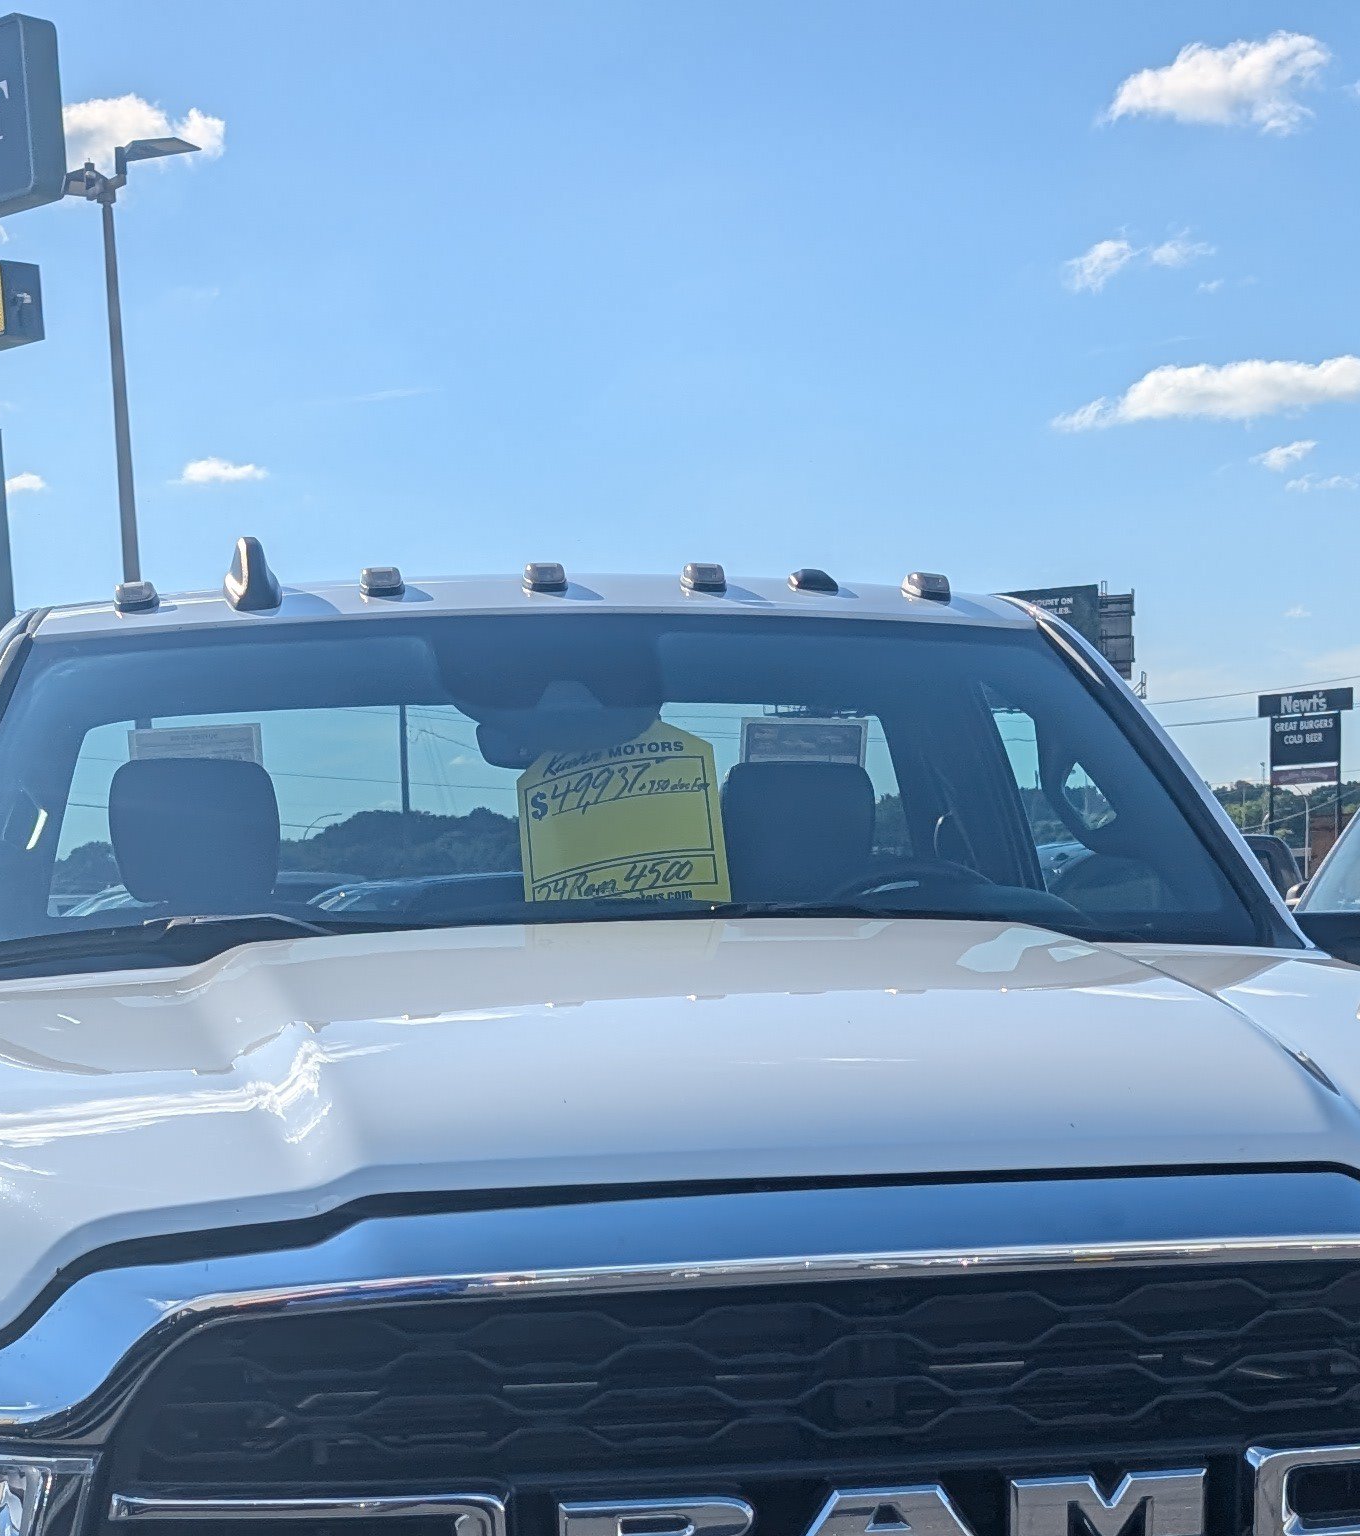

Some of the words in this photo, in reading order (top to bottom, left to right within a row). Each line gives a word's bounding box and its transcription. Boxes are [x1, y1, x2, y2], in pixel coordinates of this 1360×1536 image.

[1280, 691, 1327, 714] Newt's
[1274, 721, 1298, 732] GREAT
[1300, 718, 1334, 730] BURGERS
[1283, 735, 1303, 745] COLD
[1305, 732, 1323, 743] BEER
[608, 740, 684, 758] MOTORS
[624, 859, 694, 892] 4500
